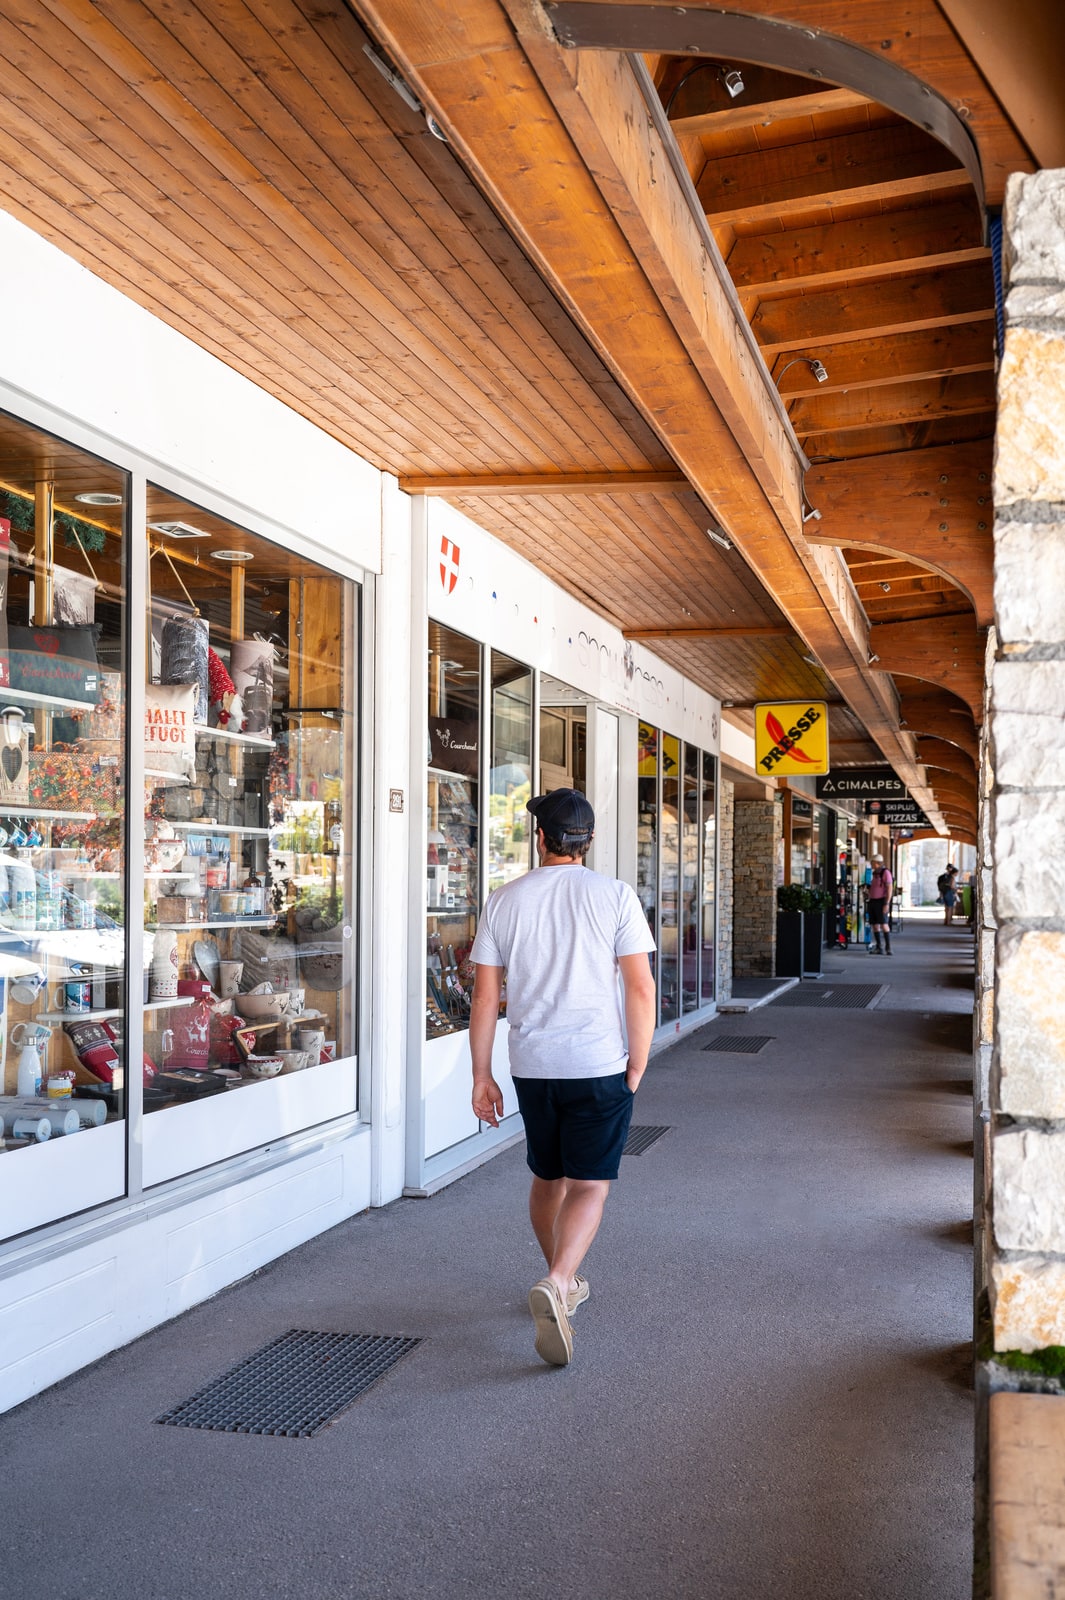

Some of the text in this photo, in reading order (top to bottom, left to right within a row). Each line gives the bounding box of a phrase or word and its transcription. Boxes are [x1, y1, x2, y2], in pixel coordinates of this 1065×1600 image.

[144, 709, 187, 726] HALET
[760, 708, 821, 771] PRESSE
[837, 780, 902, 790] CIMALPES
[885, 803, 916, 811] SKI PLUS
[884, 813, 918, 822] PIZZAS
